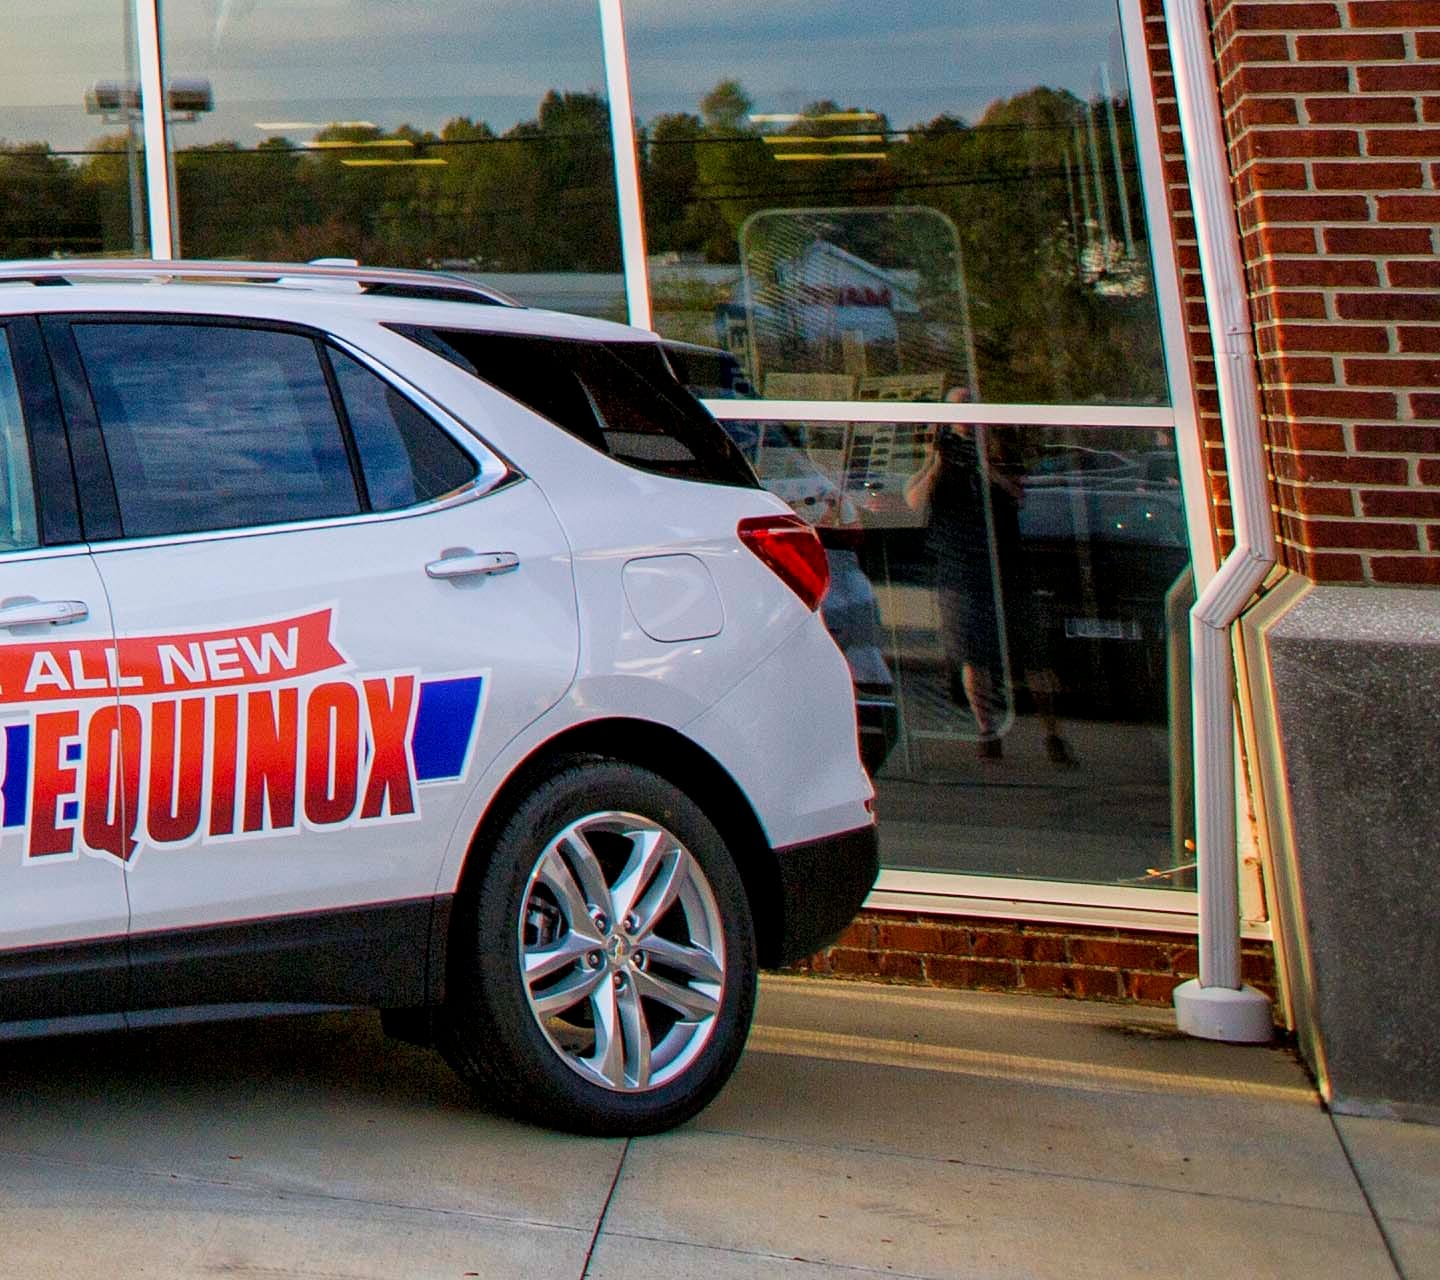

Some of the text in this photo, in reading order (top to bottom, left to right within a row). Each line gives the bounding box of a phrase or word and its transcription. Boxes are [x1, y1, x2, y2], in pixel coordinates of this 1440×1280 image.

[23, 647, 145, 694] ALL
[159, 626, 303, 683] NEW
[28, 673, 418, 864] EQUINOX
